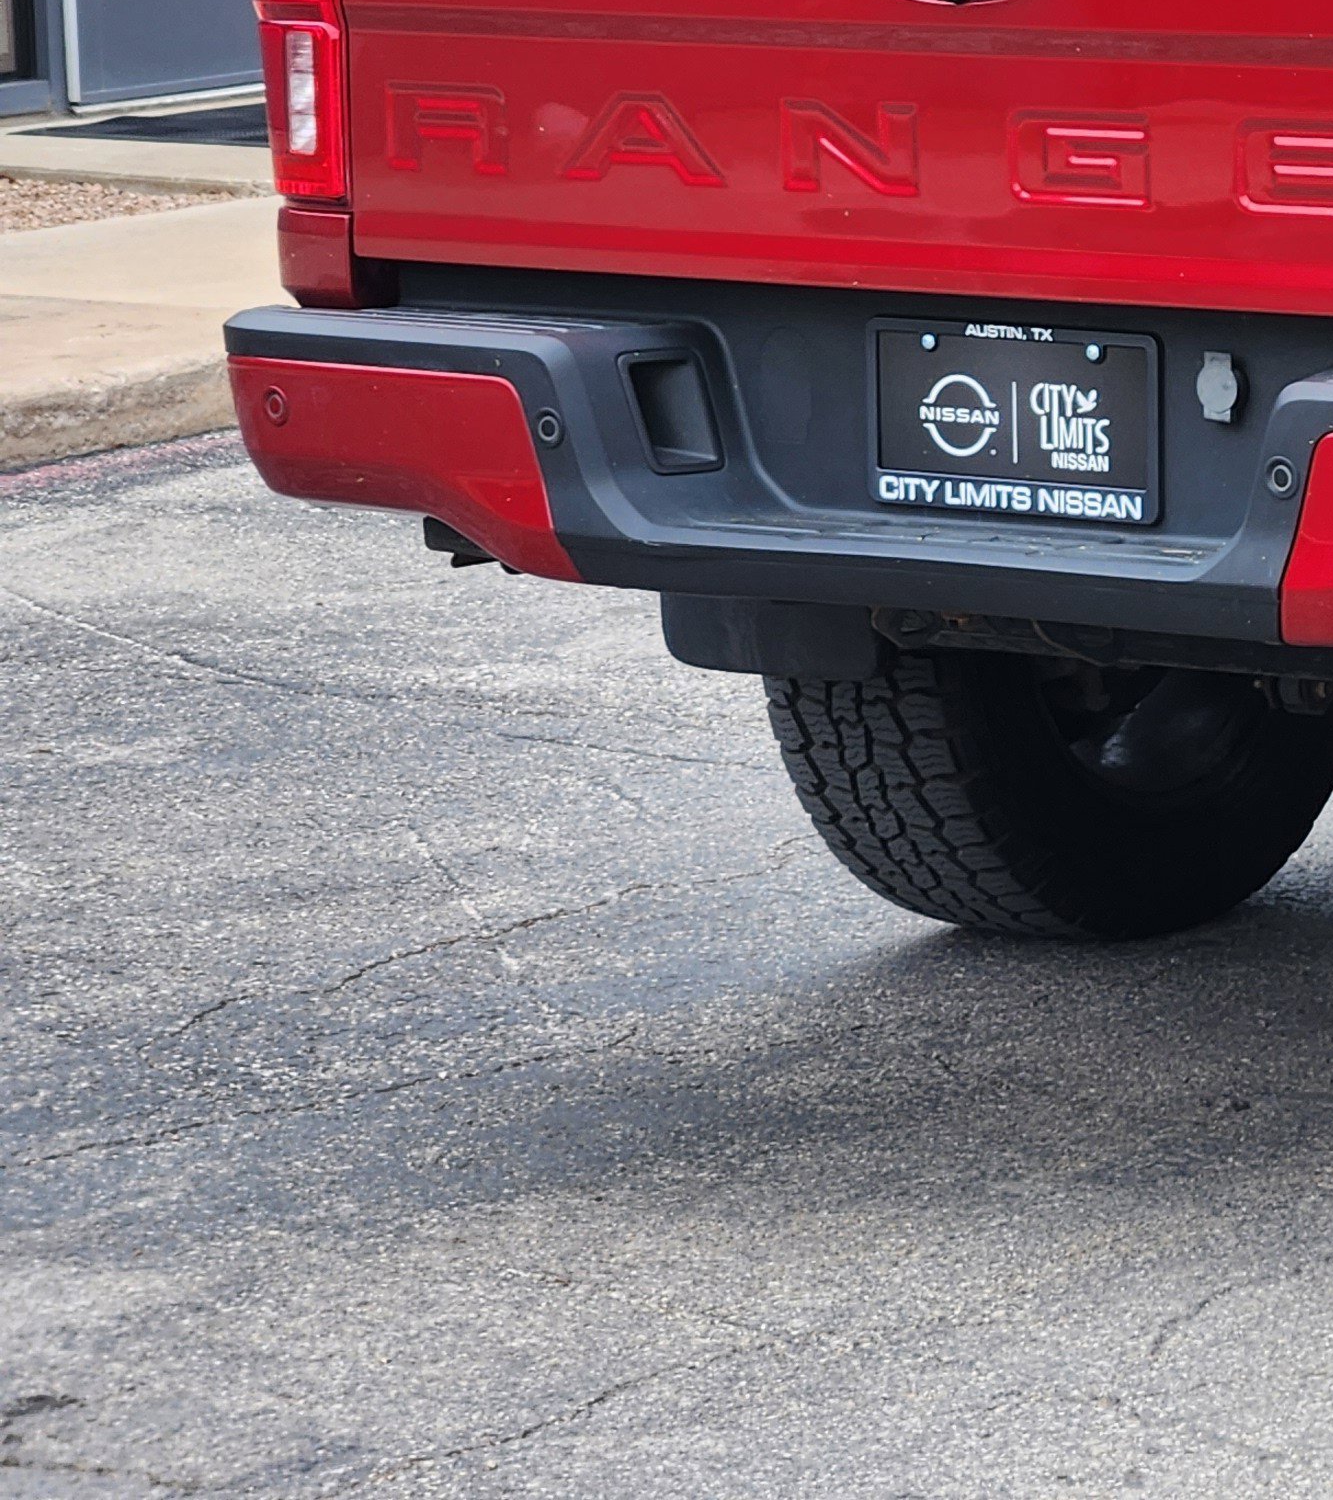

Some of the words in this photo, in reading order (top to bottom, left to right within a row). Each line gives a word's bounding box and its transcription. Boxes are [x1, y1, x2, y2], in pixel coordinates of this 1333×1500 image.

[965, 323, 1027, 341] AUSTIN,
[1031, 327, 1053, 342] TX
[1030, 382, 1078, 417] CITY
[919, 405, 1000, 425] NISSAN
[1040, 415, 1111, 455] LIMITS
[1051, 452, 1110, 472] NISSAN
[878, 475, 941, 503] CITY
[944, 480, 1032, 511] LIMITS
[1037, 488, 1142, 521] NISSAN
